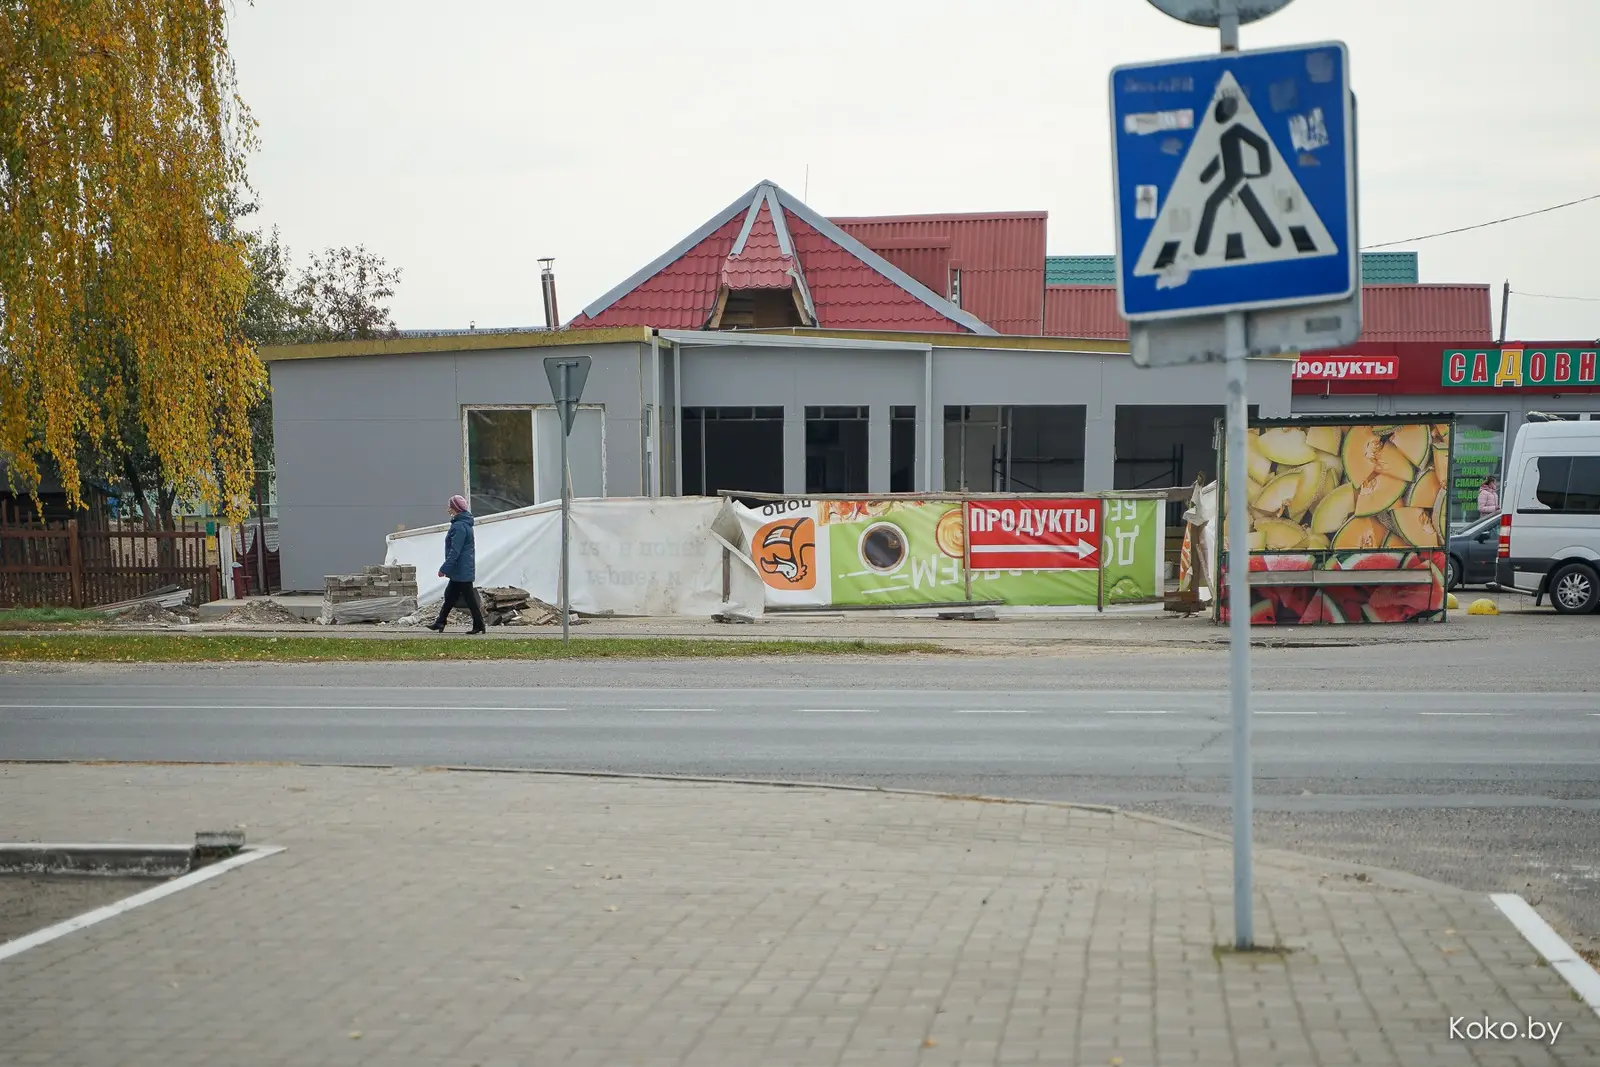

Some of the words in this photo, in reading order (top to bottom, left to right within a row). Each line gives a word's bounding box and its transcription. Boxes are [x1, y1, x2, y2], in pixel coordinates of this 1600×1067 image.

[1449, 349, 1597, 387] САДОВН
[1455, 478, 1484, 488] СПАНБО
[971, 508, 1096, 536] ПРОДУКТЫ
